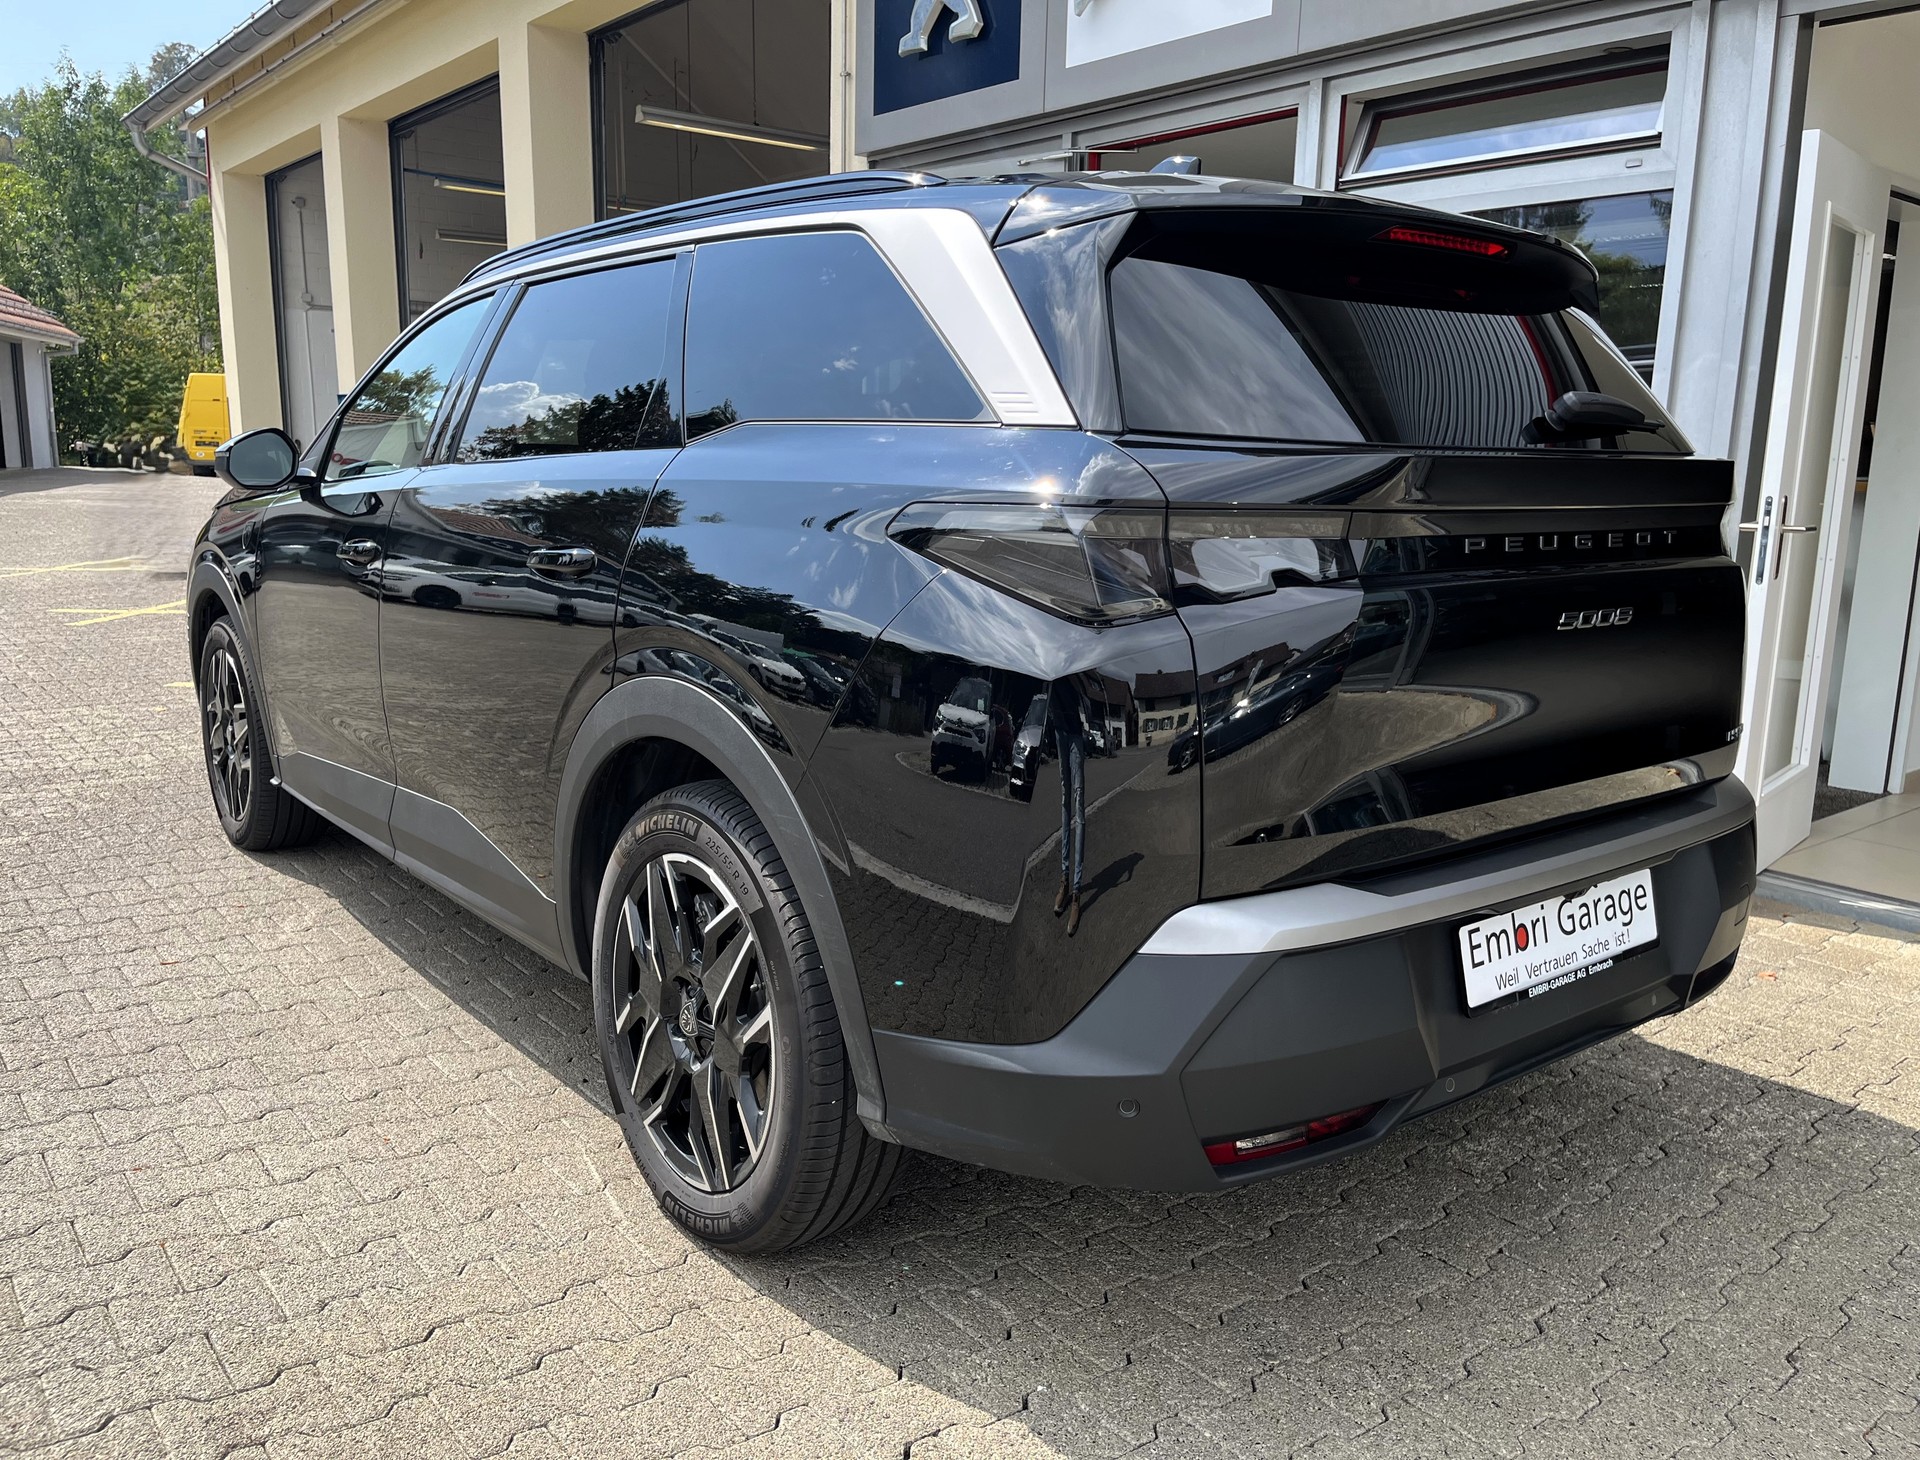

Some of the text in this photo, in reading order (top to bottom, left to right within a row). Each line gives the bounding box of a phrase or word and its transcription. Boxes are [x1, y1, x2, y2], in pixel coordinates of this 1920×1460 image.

[1465, 530, 1677, 553] PEUGEOT
[1557, 607, 1634, 630] 5008
[635, 814, 698, 840] MICHELIN
[705, 836, 749, 896] 225/55 R 19
[1467, 883, 1648, 970] Embri Garage
[1495, 970, 1520, 991] Weil
[1525, 950, 1579, 979] Vertrauen
[1581, 936, 1610, 960] Sache
[1528, 958, 1613, 998] EMBRI-GARAGE AG Embrach
[664, 1195, 731, 1235] MICHELIN
